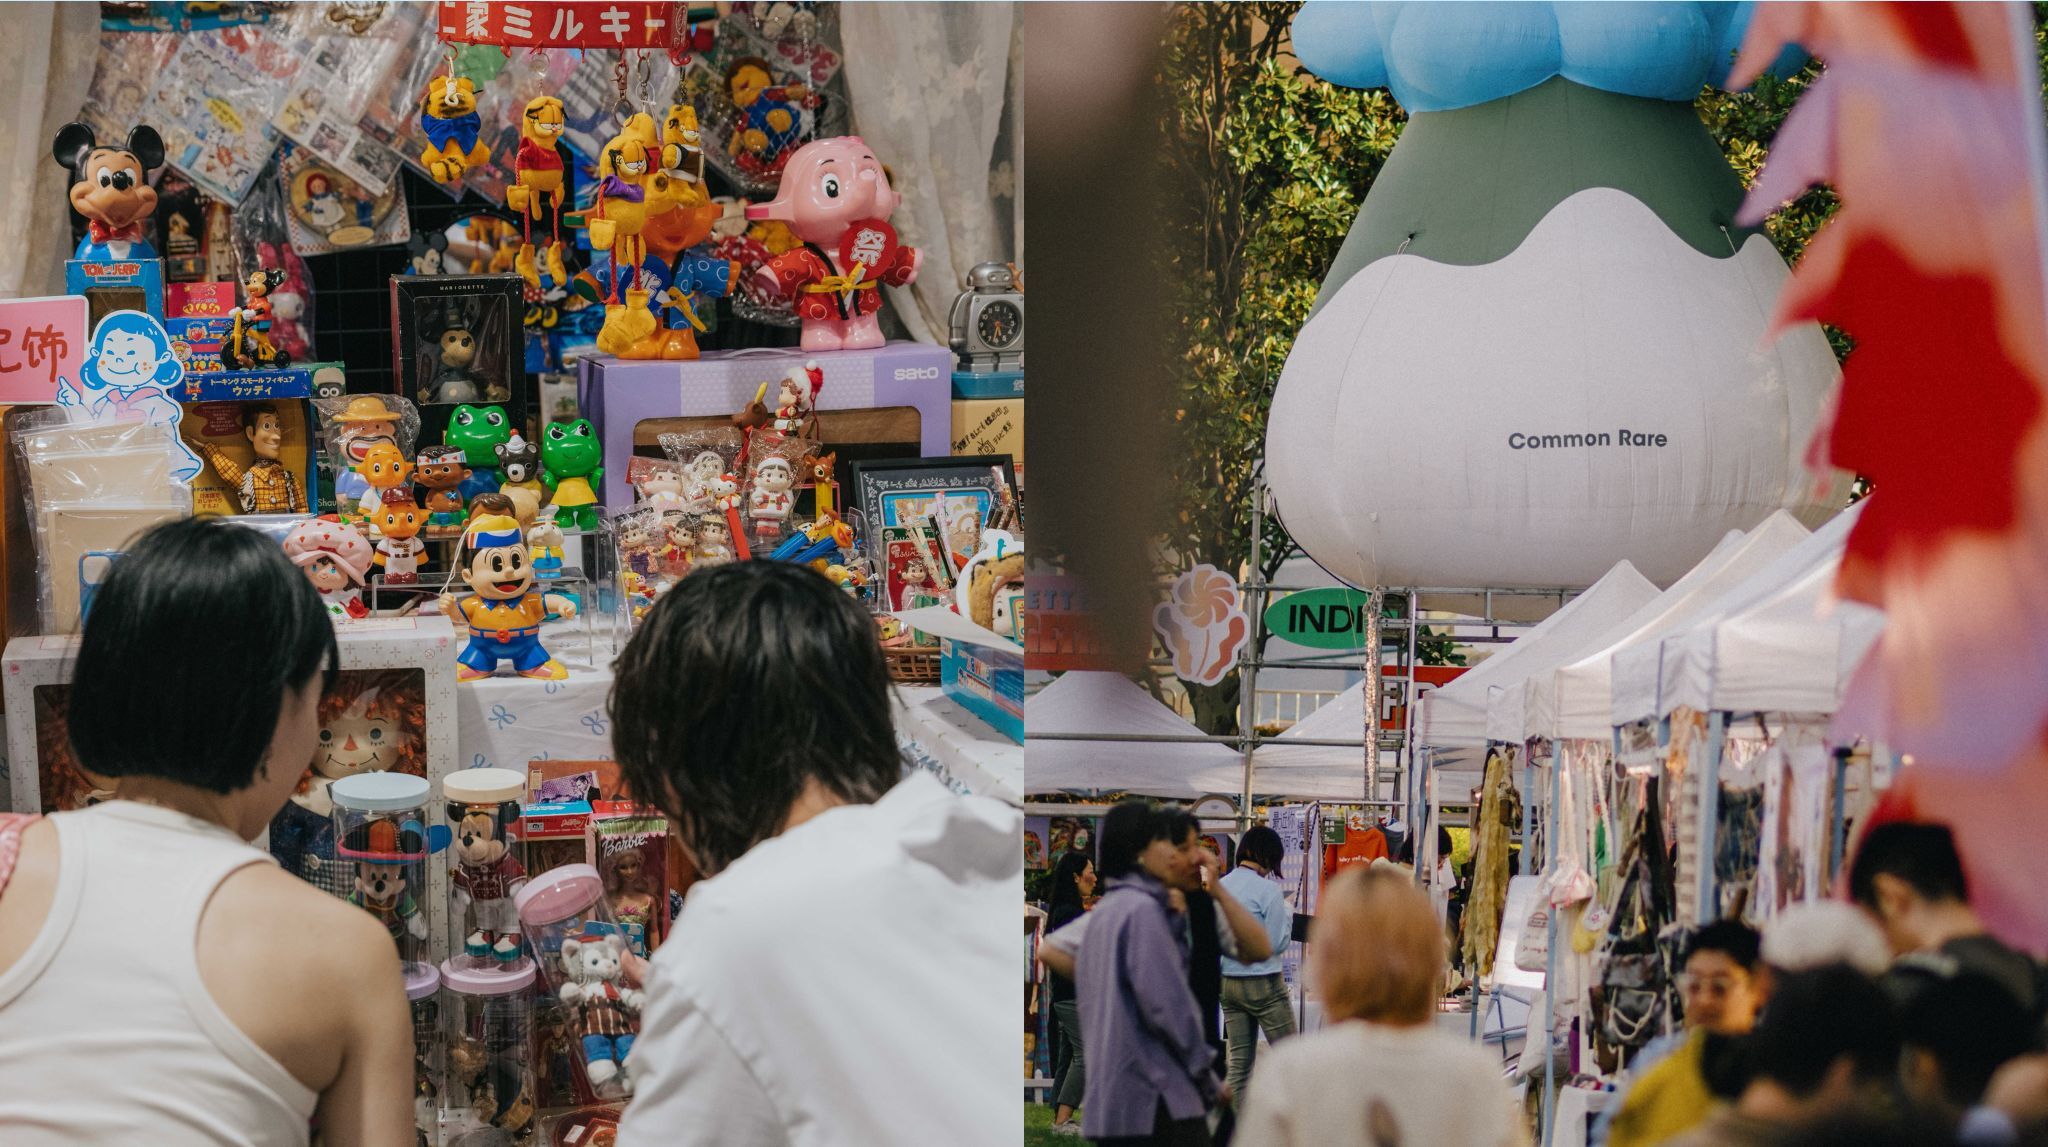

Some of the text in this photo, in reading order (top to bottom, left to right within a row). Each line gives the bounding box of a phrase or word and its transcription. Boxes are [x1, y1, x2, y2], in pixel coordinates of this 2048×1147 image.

[850, 228, 886, 267] 祭
[82, 263, 104, 277] TOM
[112, 263, 141, 276] JERRY
[894, 367, 939, 380] sato
[232, 385, 273, 396] ウッディ
[1508, 429, 1668, 450] Common Rare
[317, 498, 337, 507] Shau
[1288, 604, 1364, 633] INDI
[602, 834, 646, 859] Barbie
